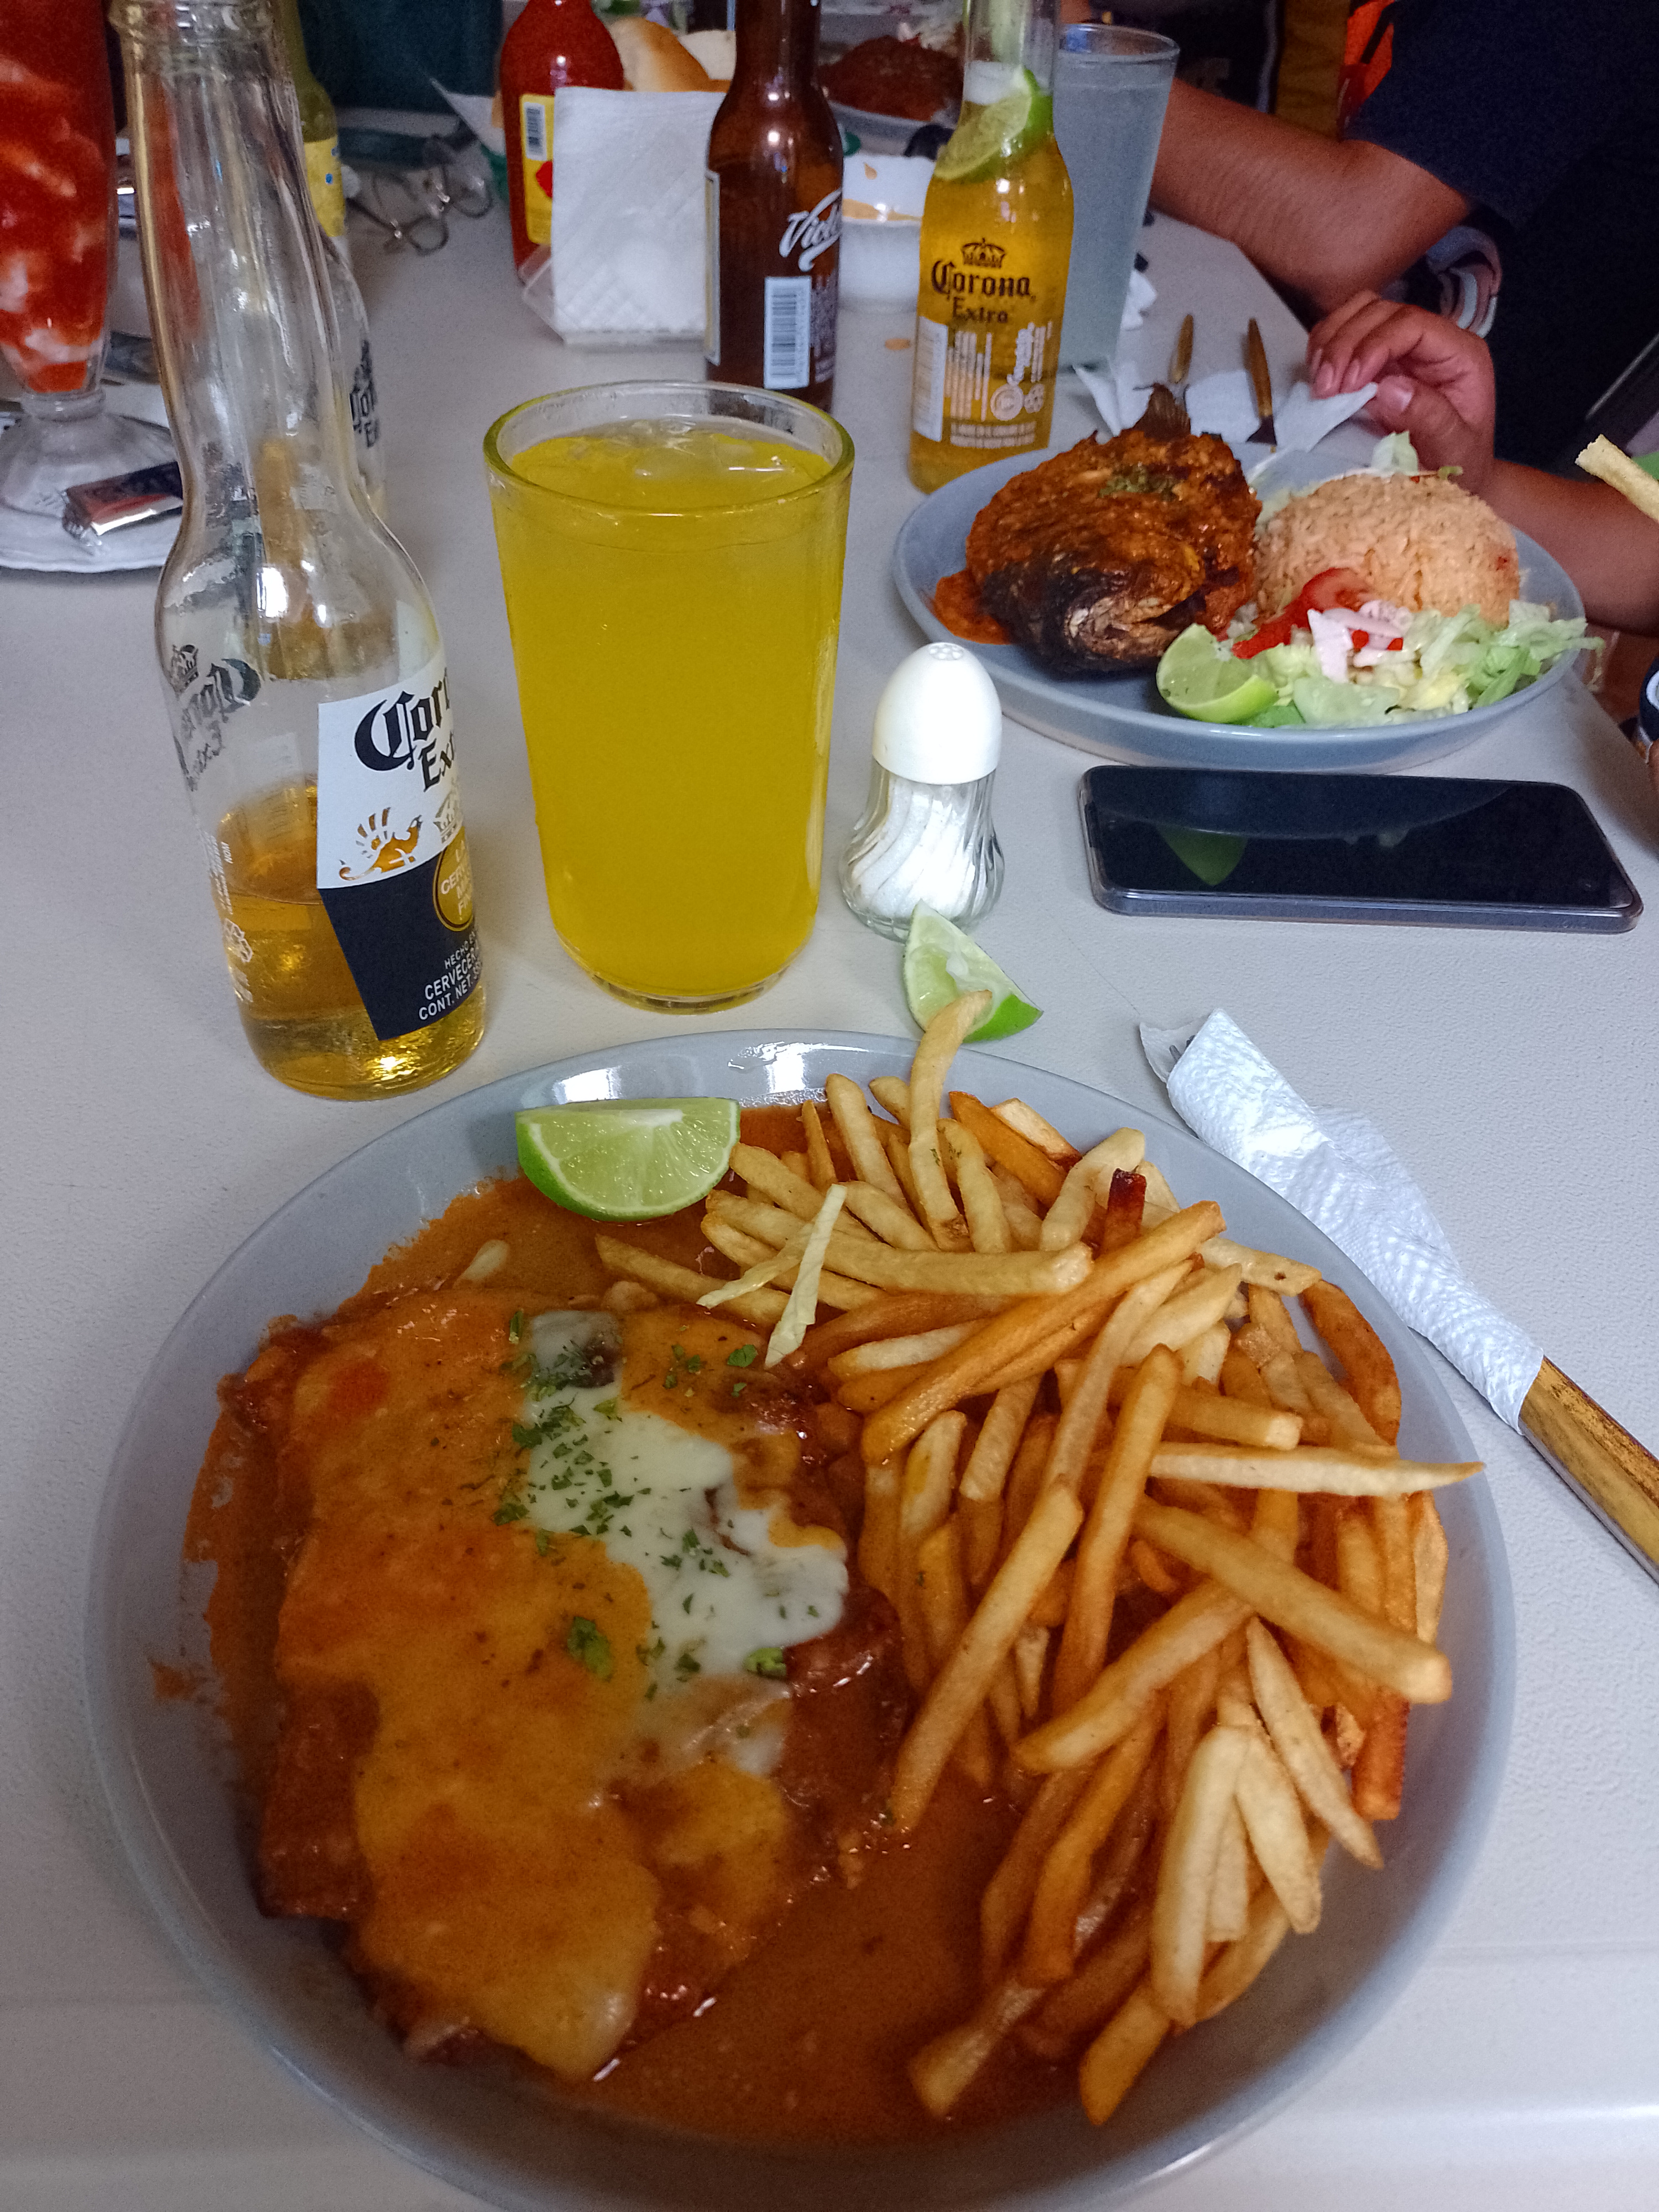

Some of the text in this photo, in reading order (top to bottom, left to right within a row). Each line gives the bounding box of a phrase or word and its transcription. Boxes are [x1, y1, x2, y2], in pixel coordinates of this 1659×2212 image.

[931, 260, 1031, 300] Corona
[952, 297, 1008, 324] Extra
[419, 974, 473, 1020] CONT. NET.
